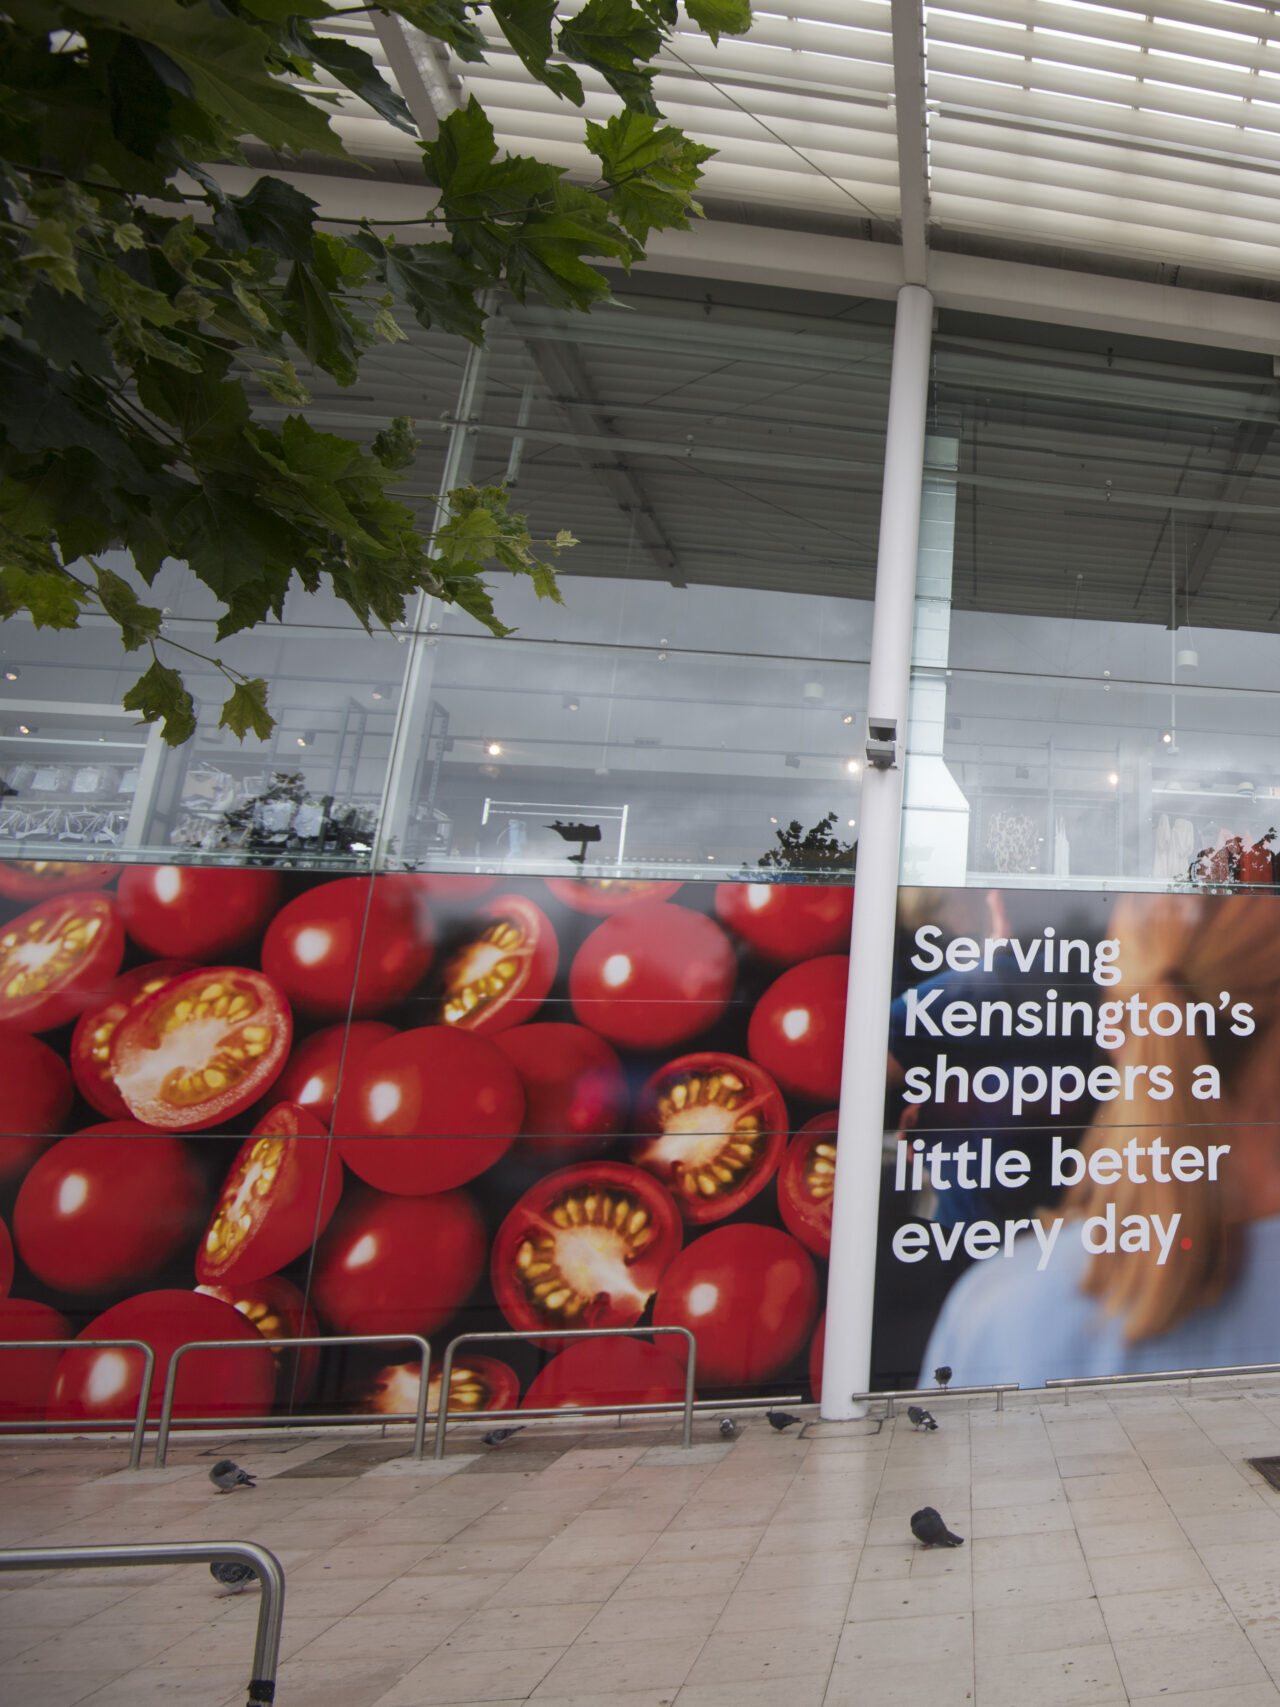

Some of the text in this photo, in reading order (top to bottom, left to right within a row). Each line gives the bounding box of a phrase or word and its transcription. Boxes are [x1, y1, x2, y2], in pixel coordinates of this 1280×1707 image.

[910, 924, 1123, 986] Serving
[904, 988, 1256, 1048] Kensington's
[902, 1054, 1221, 1116] shoppers a
[894, 1136, 1231, 1191] little better
[891, 1202, 1193, 1271] every day.
